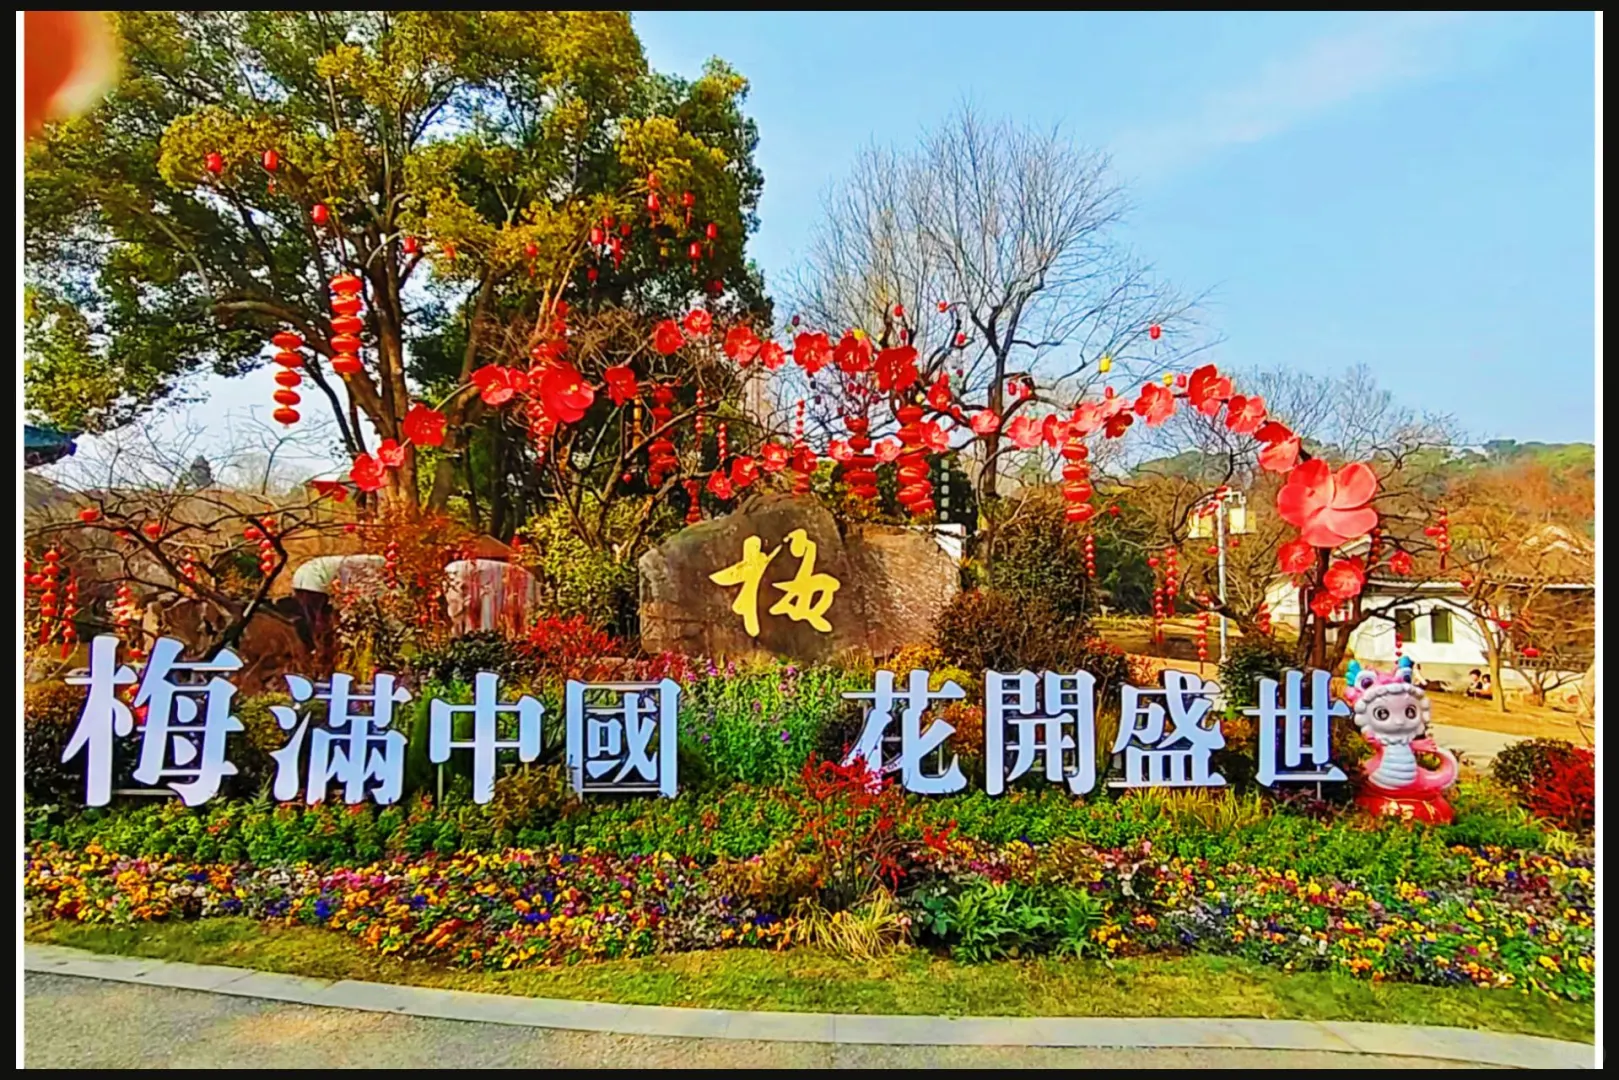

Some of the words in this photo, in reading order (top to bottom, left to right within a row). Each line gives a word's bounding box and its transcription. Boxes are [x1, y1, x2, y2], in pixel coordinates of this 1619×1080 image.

[708, 528, 841, 637] 梅
[61, 634, 682, 807] 梅滿中國
[842, 669, 1350, 796] 花開盛世
